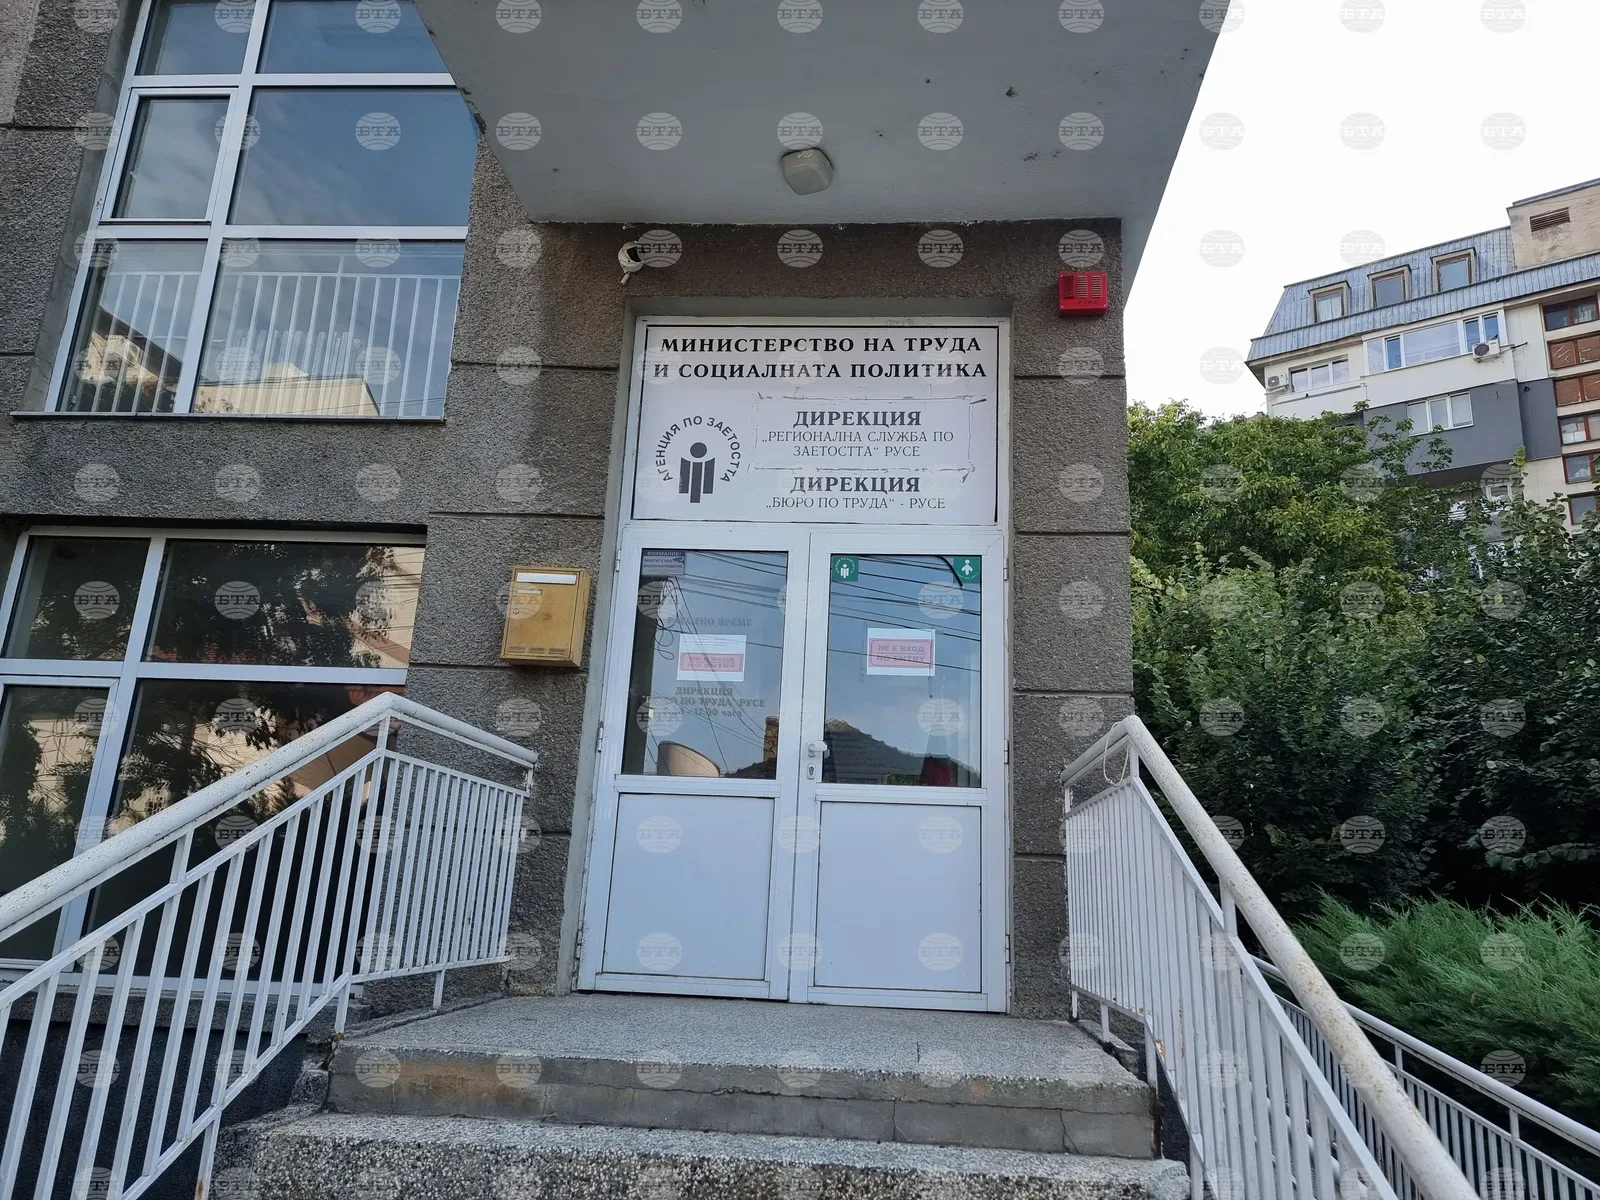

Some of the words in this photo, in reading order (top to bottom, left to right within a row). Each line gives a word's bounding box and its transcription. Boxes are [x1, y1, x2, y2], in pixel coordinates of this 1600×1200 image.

[661, 338, 854, 352] МИНИСТЕРСТВО
[863, 338, 896, 352] НА
[904, 337, 982, 353] ТРУДА
[653, 364, 669, 378] И
[678, 363, 841, 380] СОЦИАЛНАТА
[850, 363, 987, 378] ПОЛИТИКА
[792, 411, 922, 428] ДИРЕКЦИЯ
[761, 431, 862, 443] „РЕГИОНАЛНА
[867, 431, 928, 442] СЛУЖБА
[933, 431, 954, 442] ПО
[656, 423, 681, 482] АГЕНЦИЯ
[683, 416, 702, 427] ПО
[706, 417, 741, 483] ЗАЕТОСТТА
[885, 446, 920, 457] РУСЕ
[790, 477, 921, 494] ДИРЕКЦИЯ
[766, 497, 814, 509] „БЮРО
[818, 497, 839, 509] ПО
[909, 497, 946, 509] РУСЕ
[718, 617, 753, 628] ВРЕМЕ
[674, 686, 733, 696] ДИРЕКЦИЯ
[739, 698, 766, 708] РУСЕ
